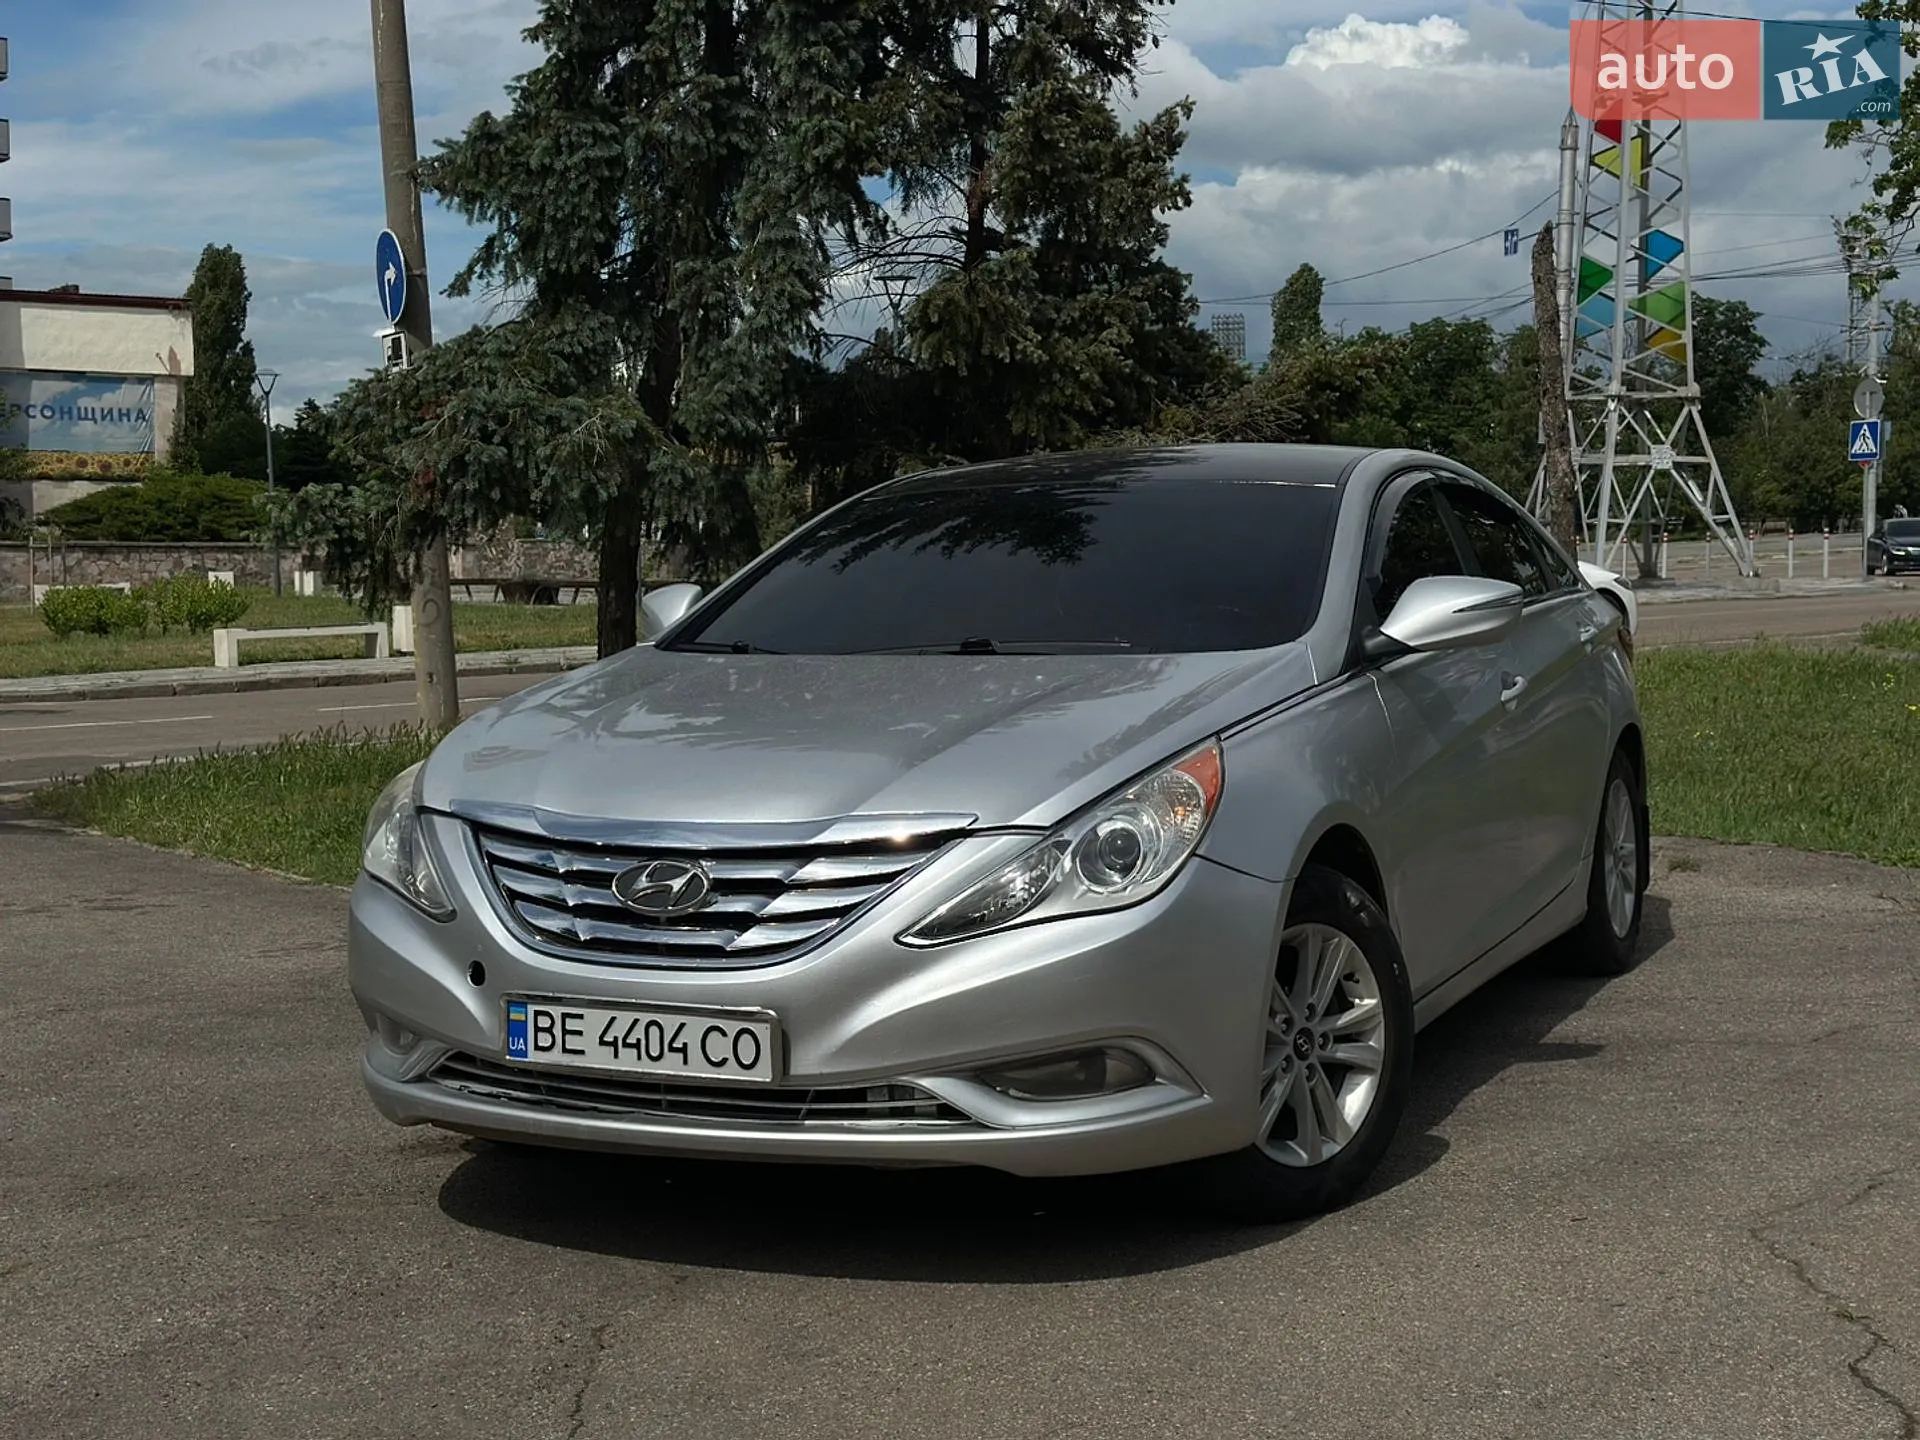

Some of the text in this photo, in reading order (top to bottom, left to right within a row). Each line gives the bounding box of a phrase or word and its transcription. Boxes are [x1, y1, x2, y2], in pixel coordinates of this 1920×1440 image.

[509, 1037, 526, 1052] UA
[533, 1009, 761, 1071] BE 4404 CO
